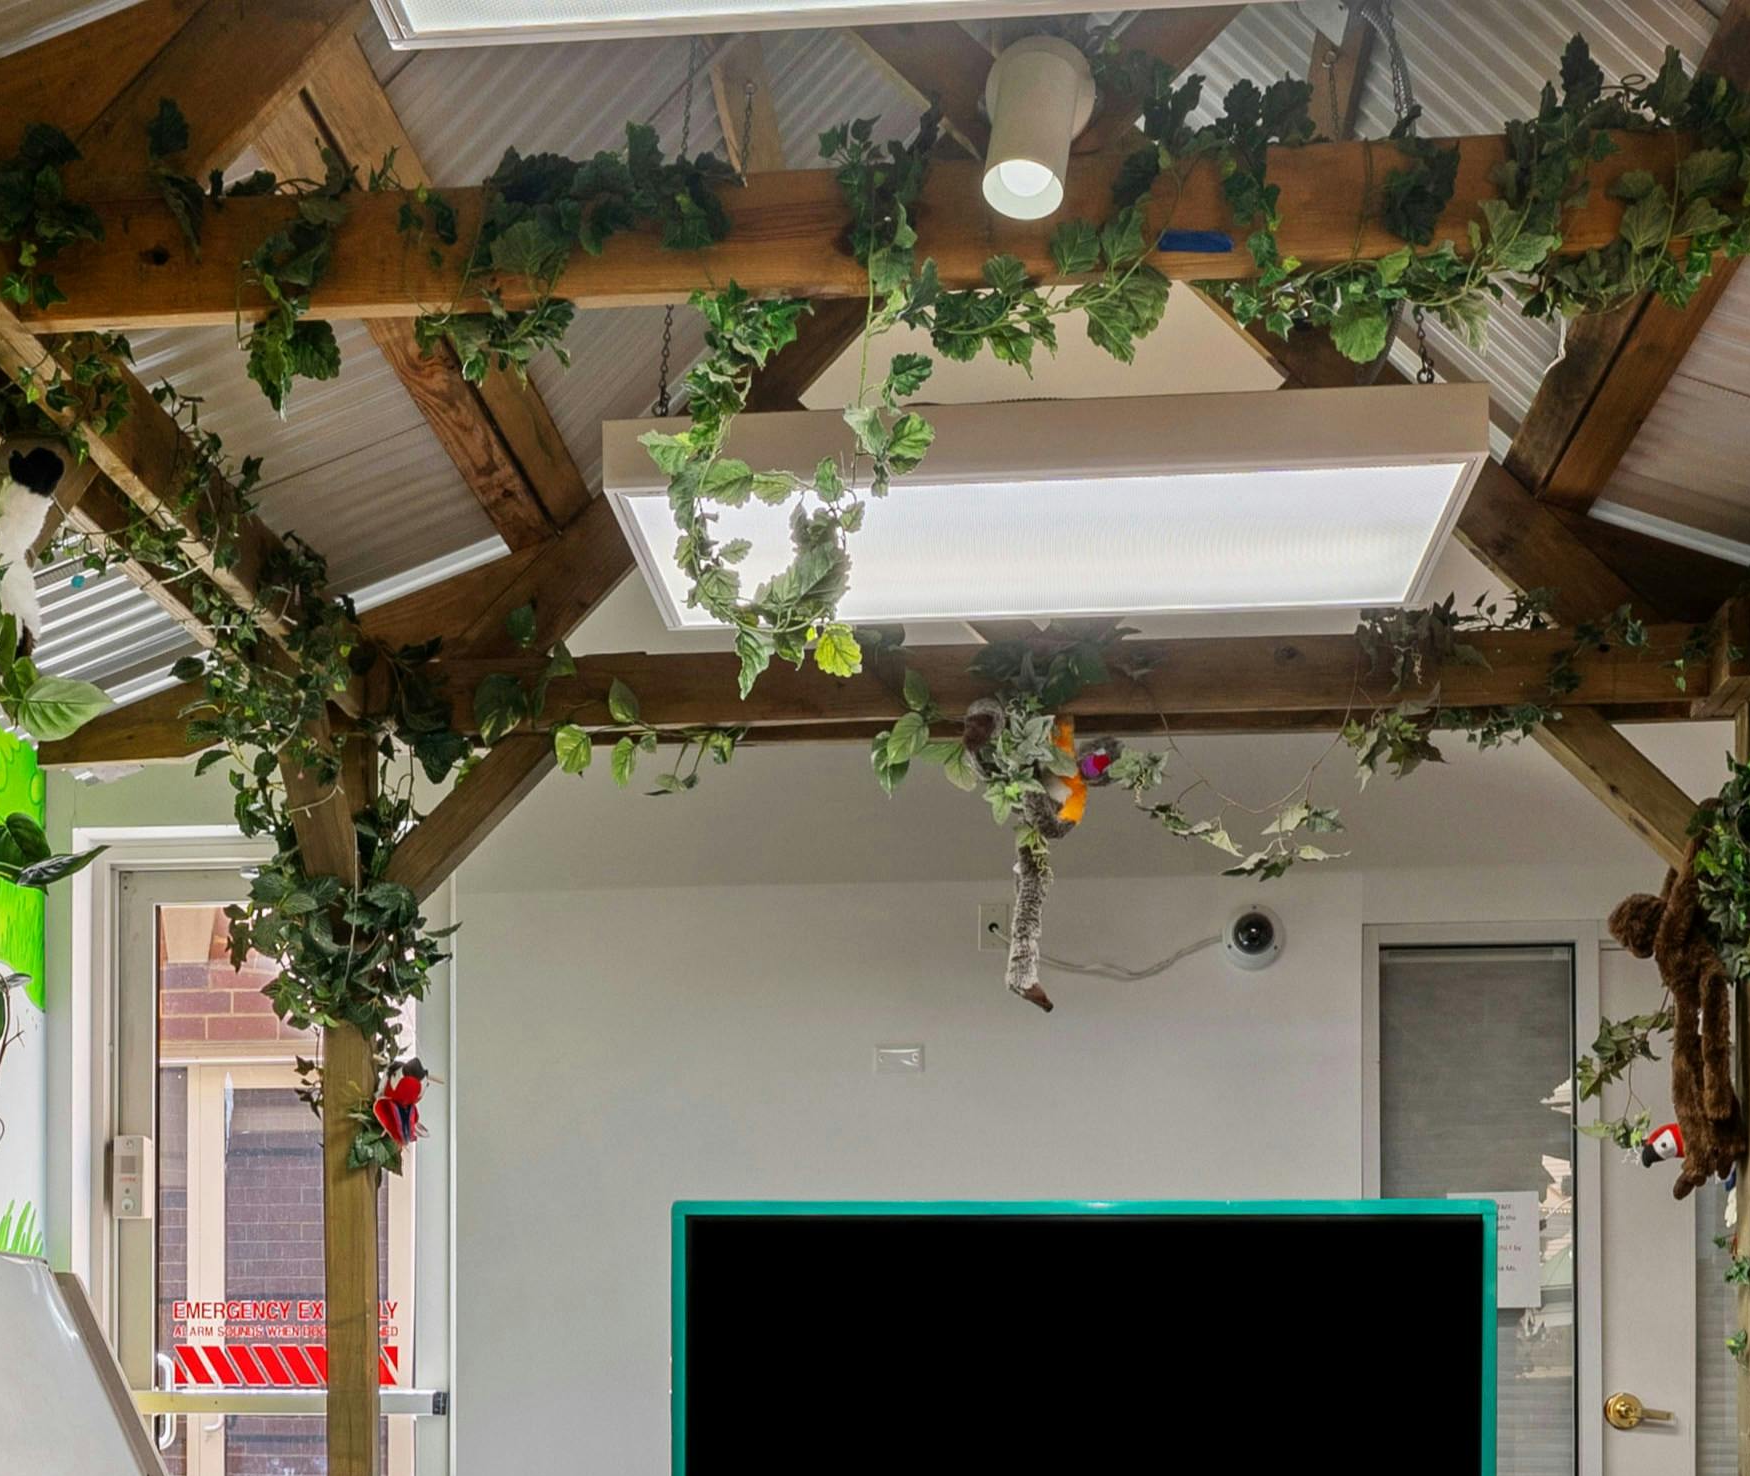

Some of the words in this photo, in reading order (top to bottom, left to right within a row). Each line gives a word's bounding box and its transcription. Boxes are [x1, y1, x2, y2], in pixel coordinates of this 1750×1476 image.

[172, 1301, 291, 1321] EMERGENCY
[297, 1301, 325, 1321] EX
[378, 1301, 399, 1320] LY
[173, 1326, 214, 1338] ALARM
[217, 1326, 264, 1338] SOUNDS
[267, 1326, 300, 1338] WHEN
